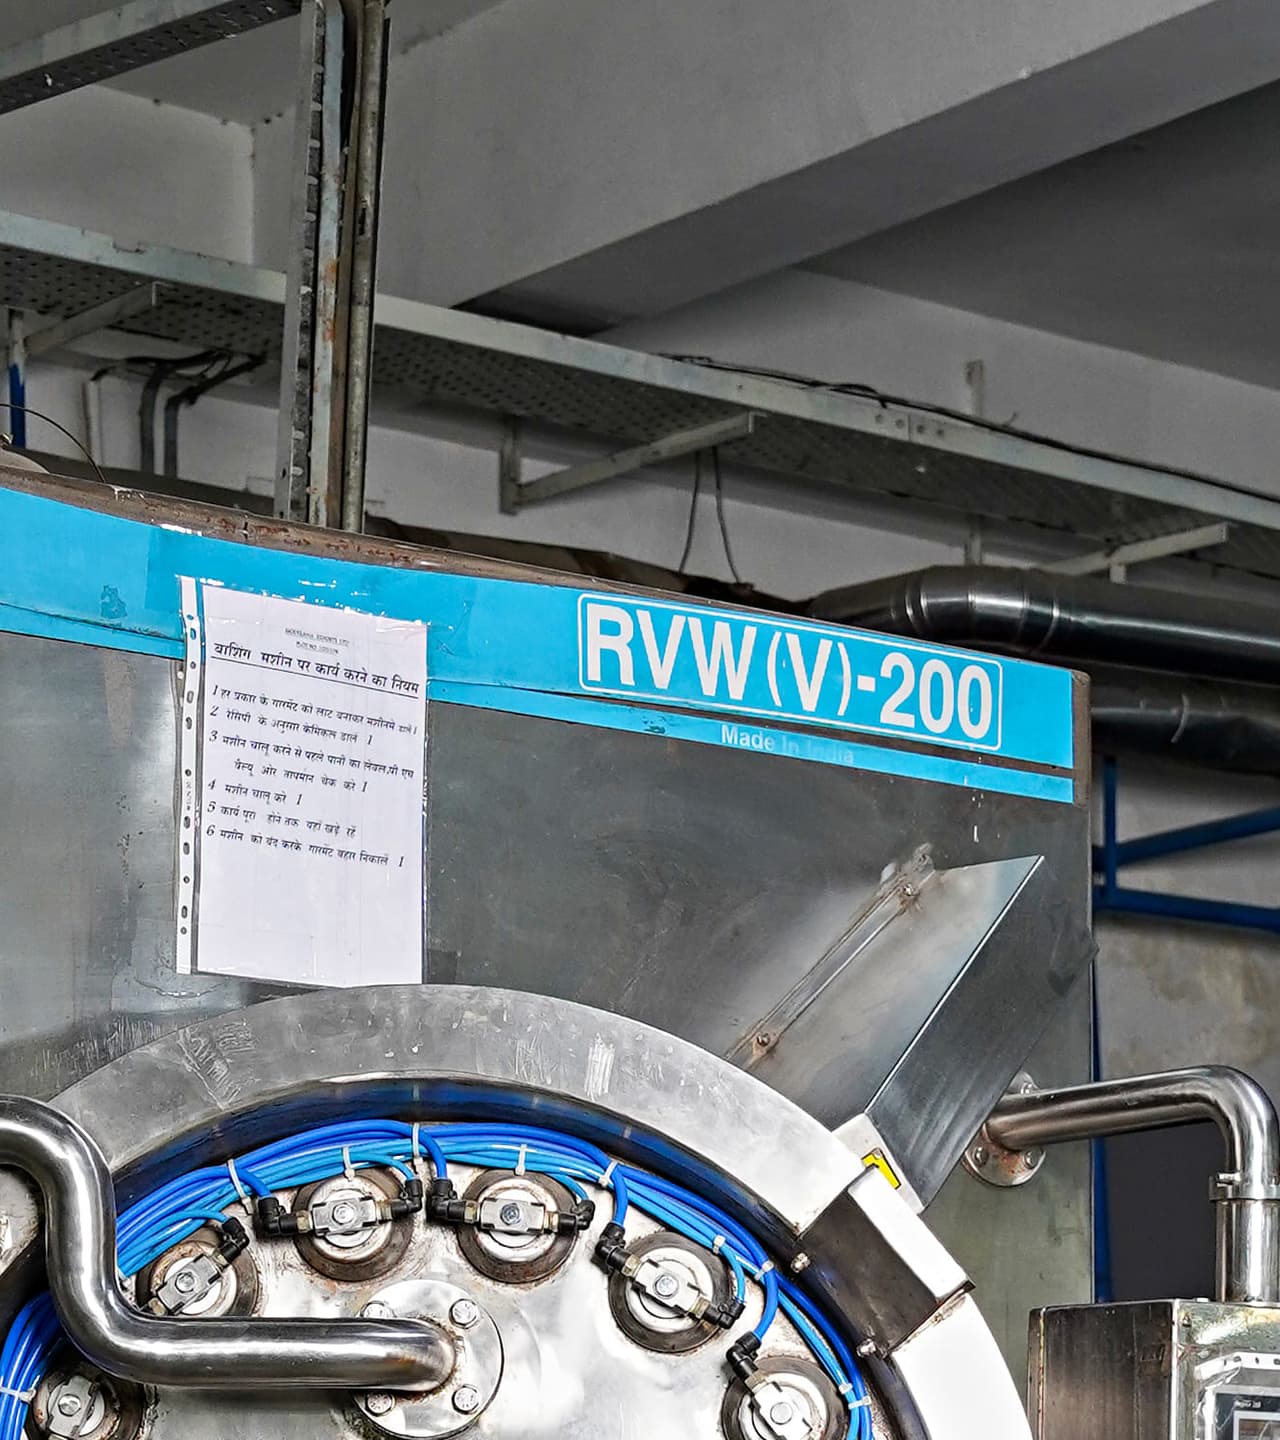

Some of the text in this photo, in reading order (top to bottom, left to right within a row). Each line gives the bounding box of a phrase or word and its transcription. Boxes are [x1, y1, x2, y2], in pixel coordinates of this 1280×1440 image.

[214, 642, 420, 694] वाशिंग मशीन पर कार्य करने का नियम
[210, 706, 219, 717] 2
[209, 730, 218, 742] 3
[222, 734, 246, 749] मशीन
[721, 725, 775, 752] Made
[225, 784, 248, 797] मशीन
[207, 801, 216, 813] 5
[206, 825, 215, 837] 6
[220, 828, 244, 842] मशीन
